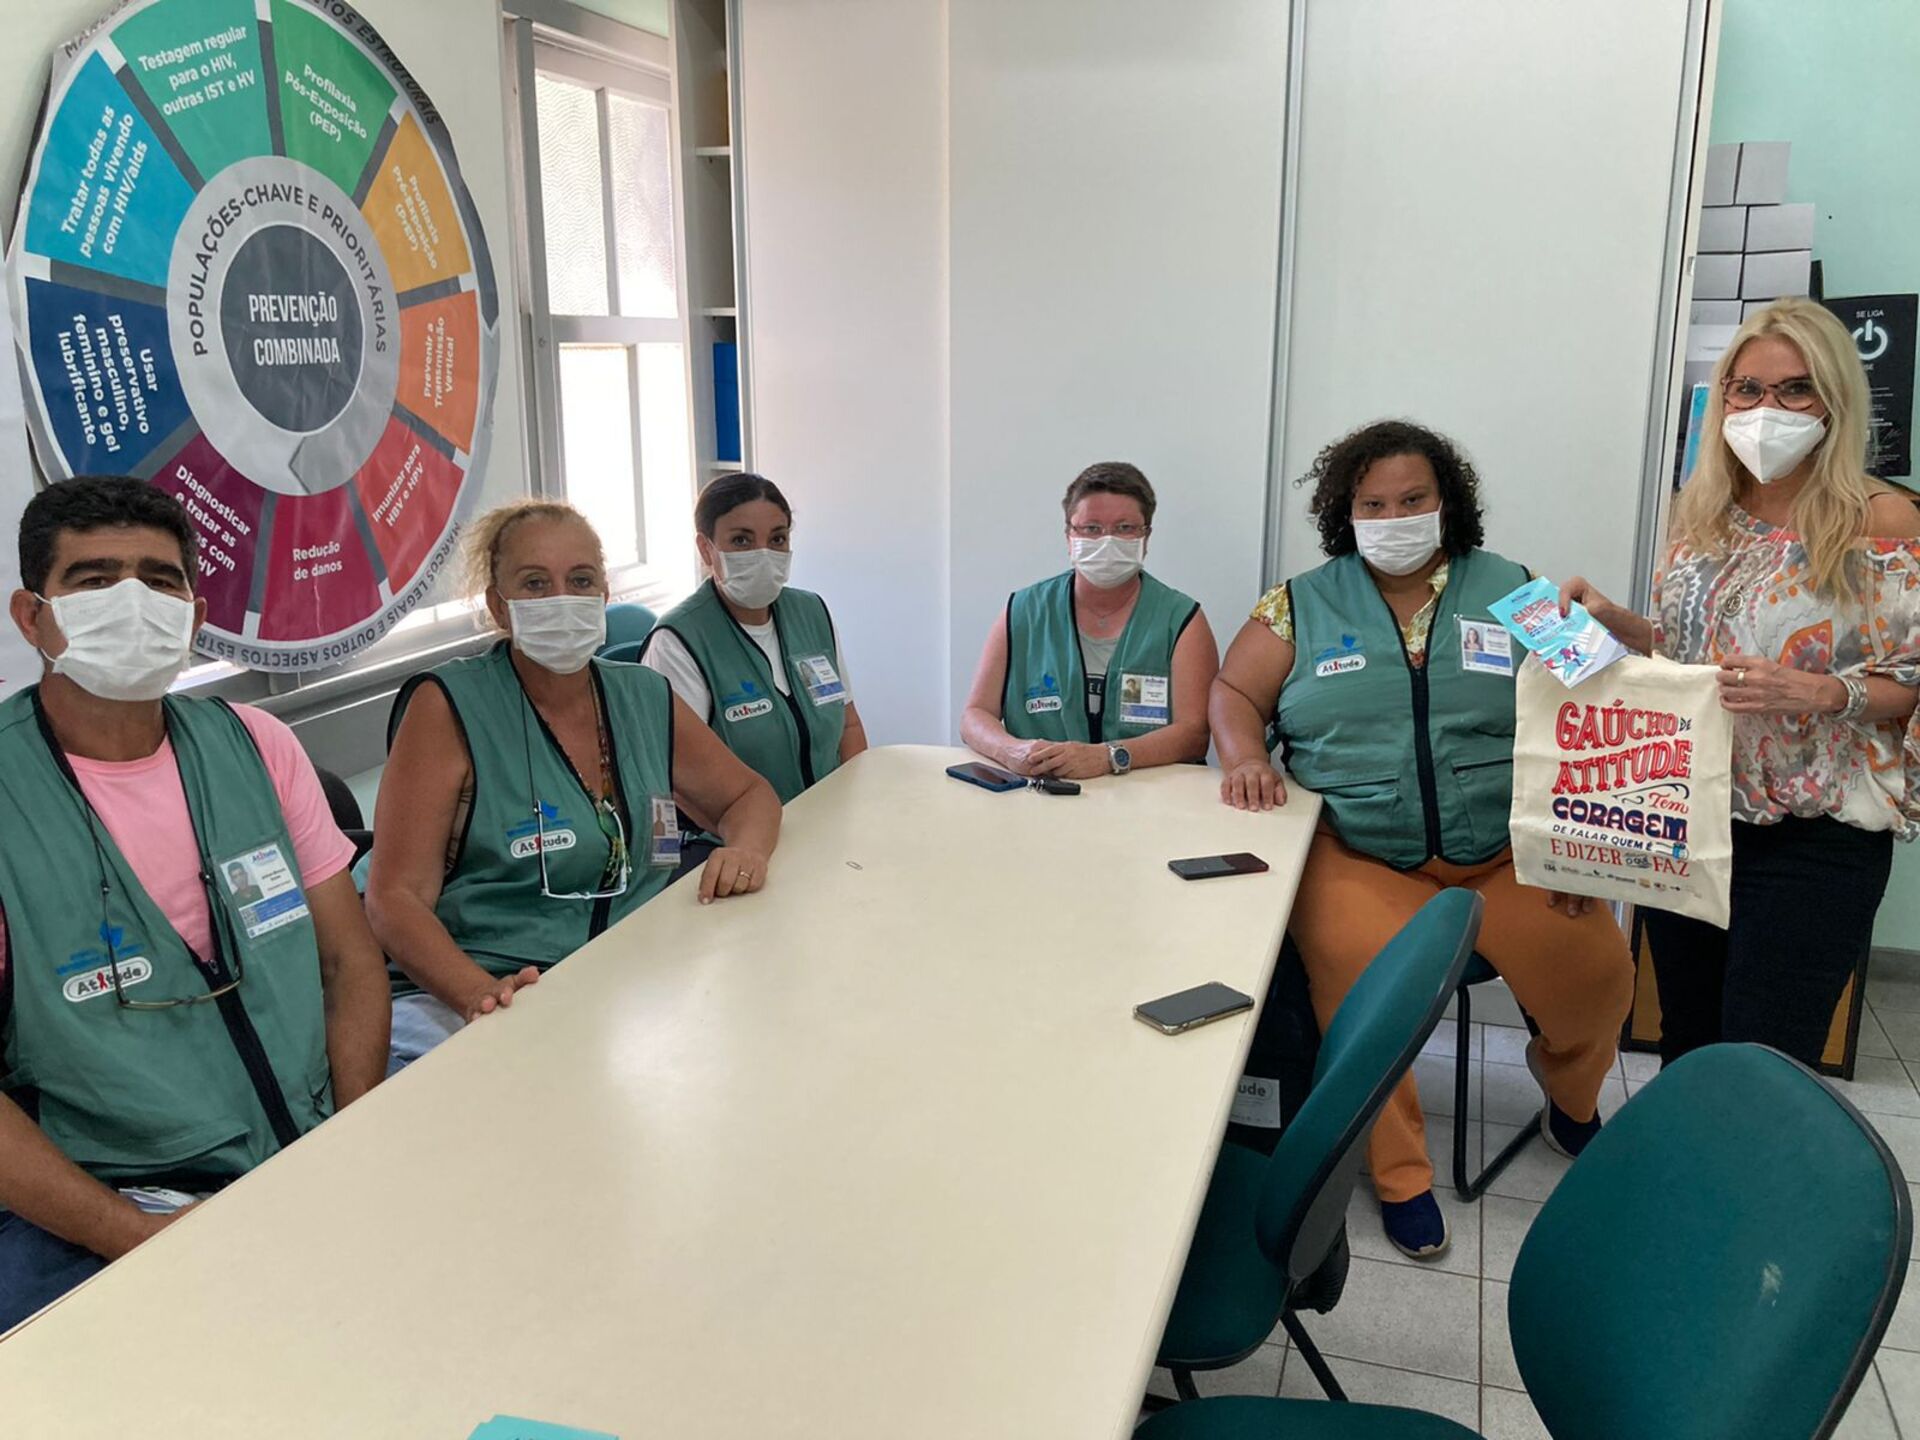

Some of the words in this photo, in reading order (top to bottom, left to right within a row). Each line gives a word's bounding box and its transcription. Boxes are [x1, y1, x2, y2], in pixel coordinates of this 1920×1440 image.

[138, 42, 203, 71] Testagem
[204, 25, 247, 51] regular
[163, 89, 204, 116] outras
[205, 81, 225, 101] IST
[227, 80, 236, 92] e
[238, 70, 255, 90] HV
[168, 67, 199, 91] para
[201, 64, 210, 77] o
[211, 53, 237, 73] HIV,
[304, 64, 357, 113] Profilaxia
[356, 24, 440, 125] ESTRUTURAIS
[285, 70, 367, 139] Pós-Exposição
[309, 111, 342, 142] (PEP)
[61, 179, 90, 235] Tratar
[81, 128, 108, 179] todas
[102, 105, 115, 128] as
[80, 185, 110, 258] pessoas
[104, 113, 134, 183] vivendo
[103, 215, 123, 255] com
[113, 140, 148, 215] HIV/aids
[409, 175, 439, 245] Profilaxia
[188, 183, 304, 356] POPULAÇÕES-CHAVE
[307, 194, 319, 214] E
[321, 204, 386, 353] PRIORITÁRIAS
[248, 291, 338, 327] PREVENÇÃO
[428, 322, 435, 333] a
[73, 313, 104, 401] feminino
[108, 314, 149, 434] preservativo
[139, 349, 158, 391] Usar
[253, 337, 341, 366] COMBINADA
[424, 337, 434, 398] Prevenir
[434, 316, 446, 408] Transmissão
[445, 336, 454, 393] Vertical
[58, 331, 96, 445] lubrificante
[95, 327, 129, 431] masculino,
[97, 406, 109, 418] e
[100, 422, 121, 452] gel
[176, 465, 251, 536] Diagnosticar
[372, 470, 406, 522] Imunizar
[404, 444, 421, 474] para
[385, 496, 404, 527] HBV
[403, 490, 410, 500] e
[407, 462, 423, 491] HPV
[175, 492, 185, 503] e
[186, 499, 222, 534] tratar
[221, 529, 237, 547] as
[209, 545, 236, 571] com
[293, 541, 341, 562] Redução
[294, 567, 308, 580] de
[311, 560, 343, 577] danos
[425, 522, 461, 581] MARCOS
[387, 580, 428, 625] LEGAIS
[196, 632, 234, 658] ESTR
[324, 627, 376, 661] OUTROS
[378, 618, 386, 635] E
[242, 648, 319, 667] ASPECTOS
[1556, 699, 1677, 751] GAÚCHO
[1680, 718, 1692, 732] DE
[1552, 740, 1692, 795] ATITUDE
[1553, 797, 1687, 843] CORAGEM
[1649, 792, 1689, 814] Tem
[1551, 838, 1562, 856] E
[1566, 841, 1622, 866] DIZER
[1653, 856, 1690, 877] FAZ
[1553, 824, 1565, 834] DE
[1570, 828, 1608, 842] FALAR
[1611, 836, 1643, 849] QUEM
[78, 967, 141, 995] Atitde
